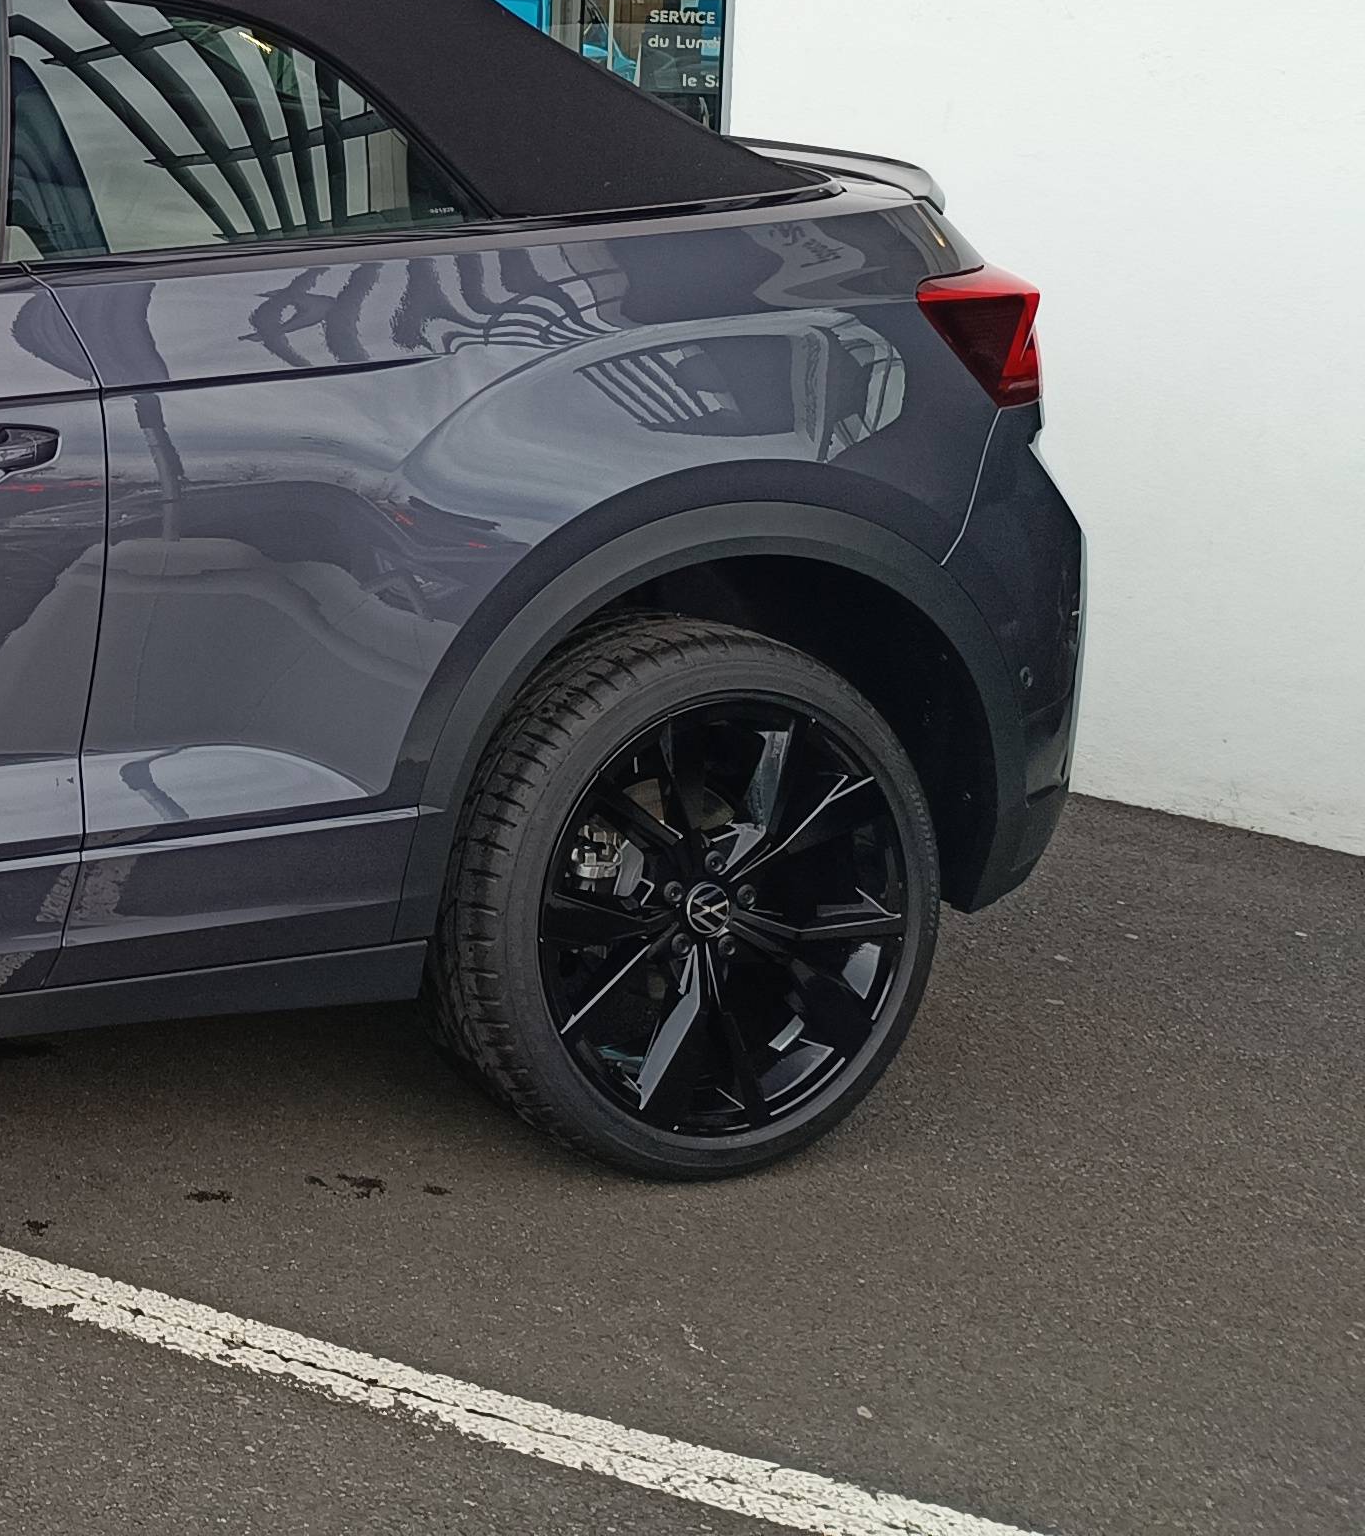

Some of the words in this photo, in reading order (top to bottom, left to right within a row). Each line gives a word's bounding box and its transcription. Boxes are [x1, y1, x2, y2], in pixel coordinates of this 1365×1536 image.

[649, 10, 716, 25] SERVICE
[648, 34, 669, 48] du
[682, 73, 697, 87] le
